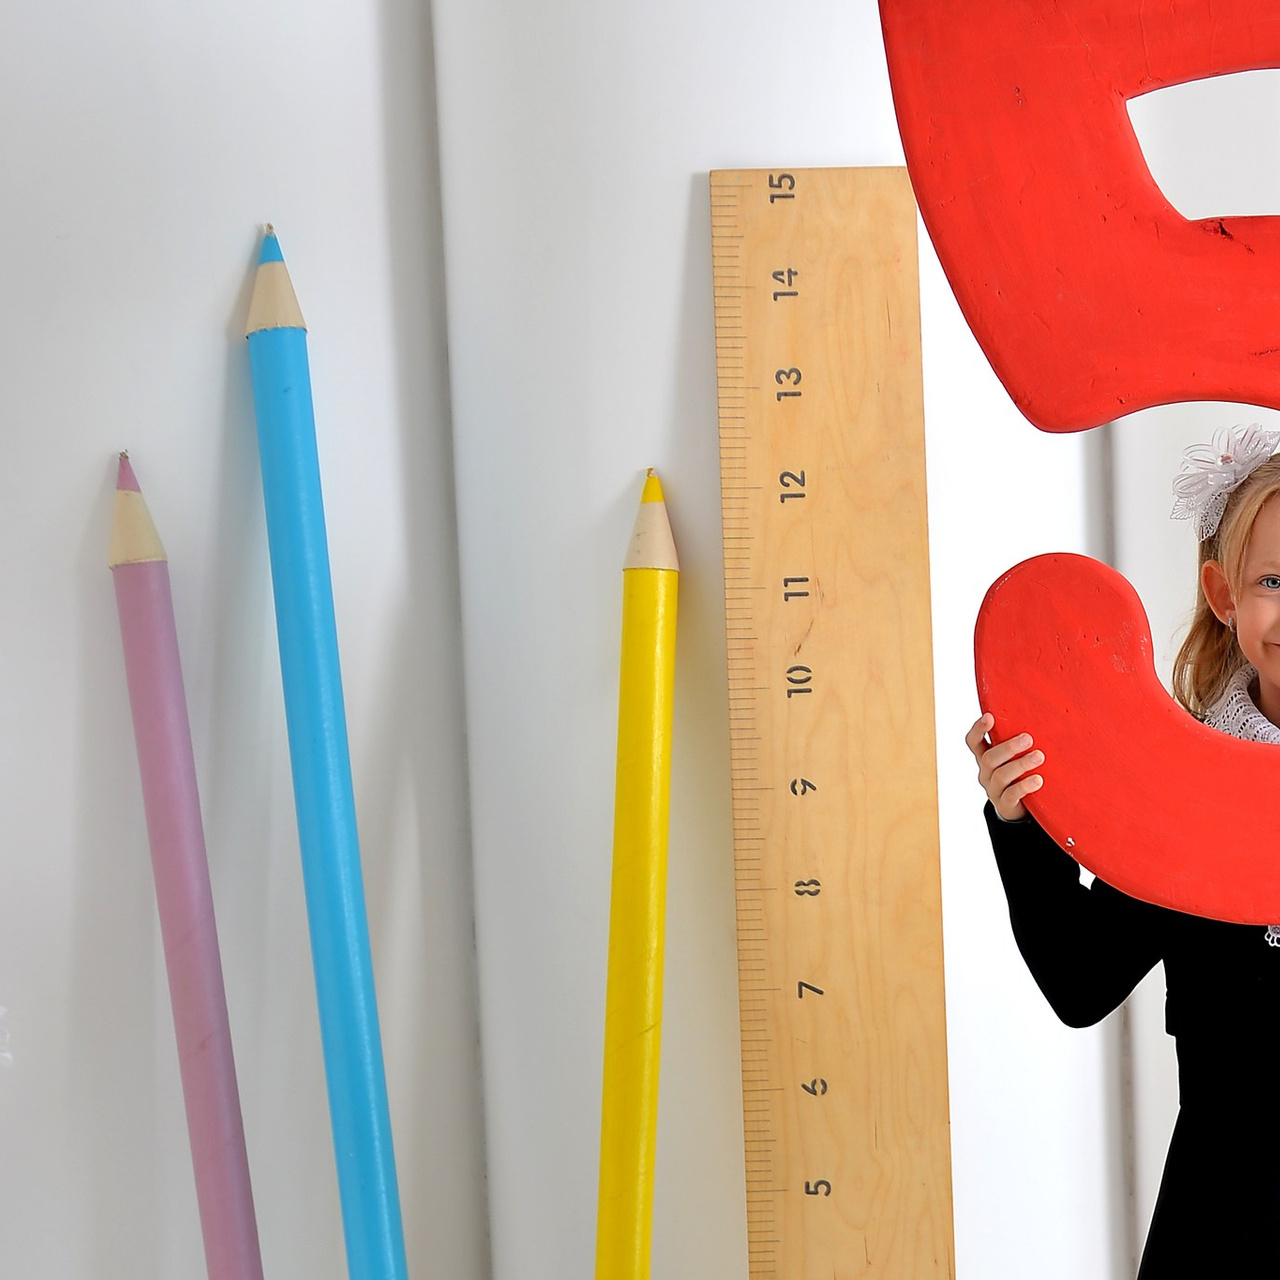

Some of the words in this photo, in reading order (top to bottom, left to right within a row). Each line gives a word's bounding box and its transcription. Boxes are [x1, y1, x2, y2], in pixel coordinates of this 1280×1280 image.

[769, 173, 795, 203] 15
[772, 268, 798, 301] 14
[775, 367, 802, 401] 13
[780, 470, 806, 503] 12
[783, 577, 809, 602] 11
[786, 665, 812, 698] 10
[790, 778, 817, 796] 9
[794, 879, 820, 896] 8
[798, 981, 824, 998] 7
[801, 1078, 827, 1095] 6
[805, 1180, 831, 1197] 5
